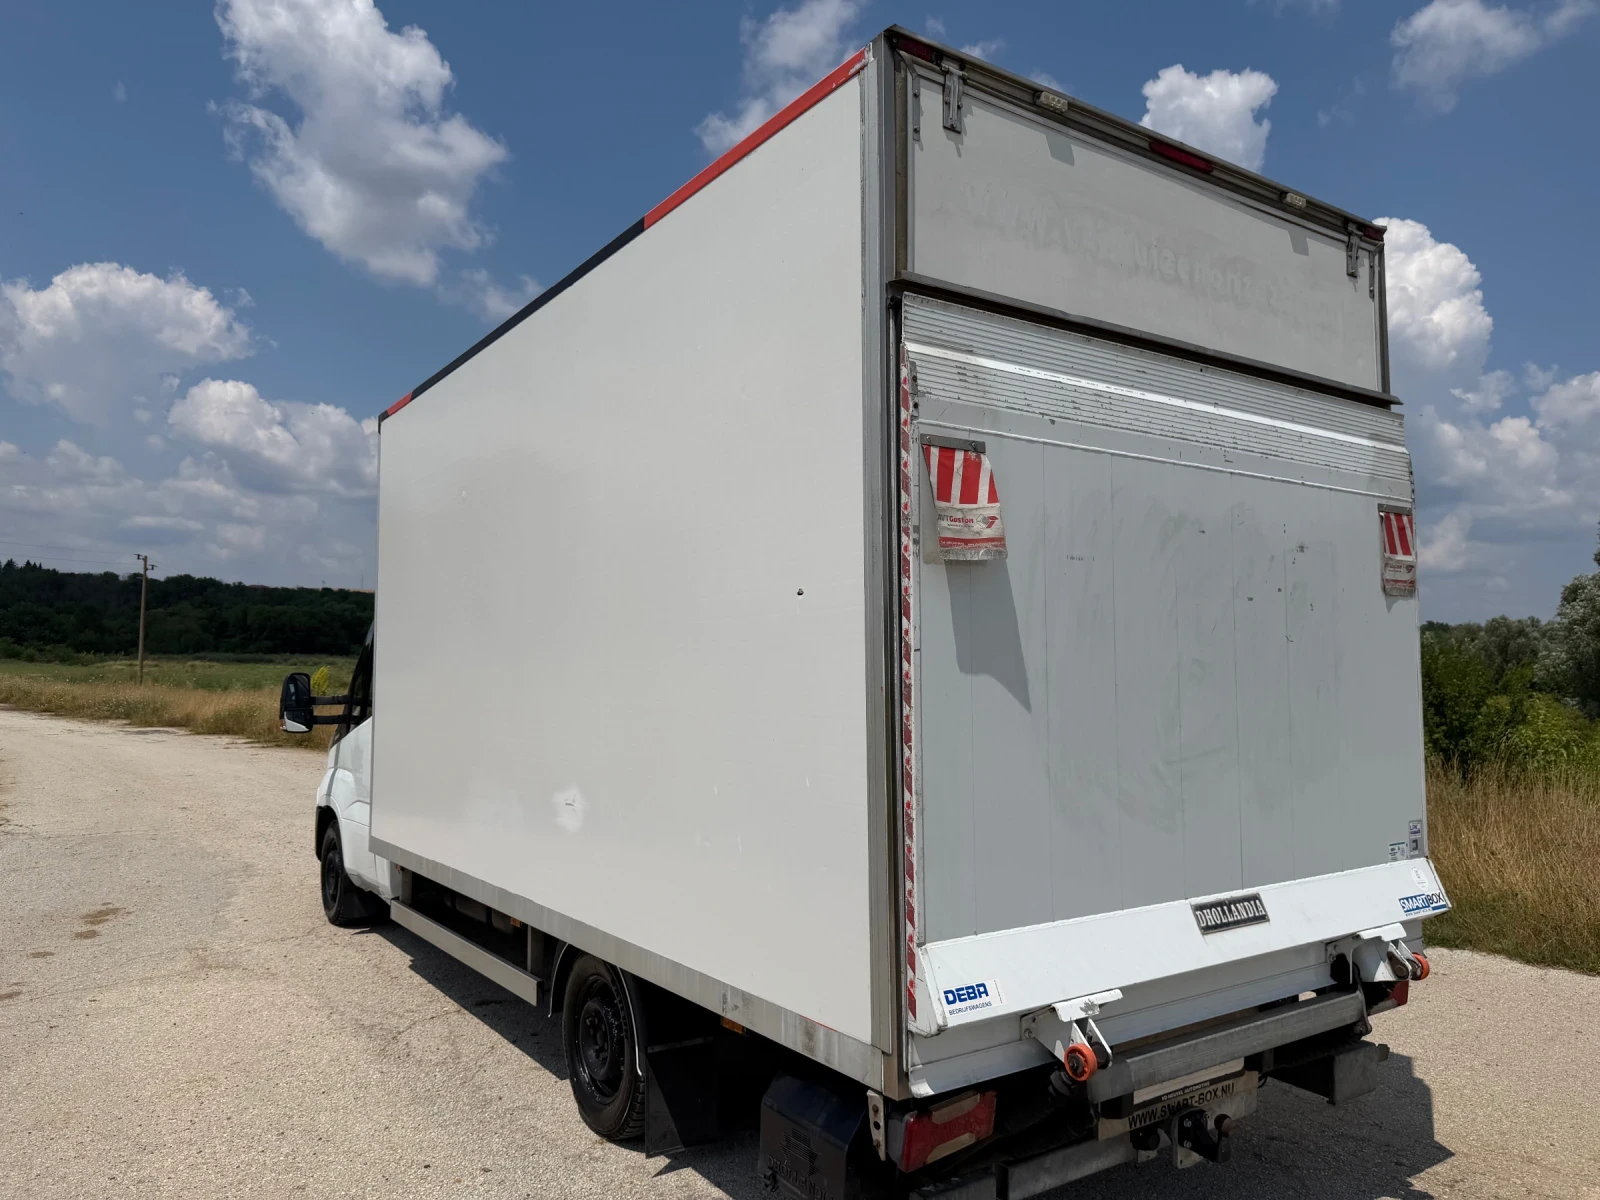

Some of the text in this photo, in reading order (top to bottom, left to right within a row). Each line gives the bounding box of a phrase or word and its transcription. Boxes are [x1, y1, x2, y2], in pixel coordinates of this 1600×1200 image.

[1195, 899, 1266, 927] DHOLLANDIA
[943, 982, 989, 1006] DEBA
[948, 1000, 993, 1016] BEDRIJFSWAGENS
